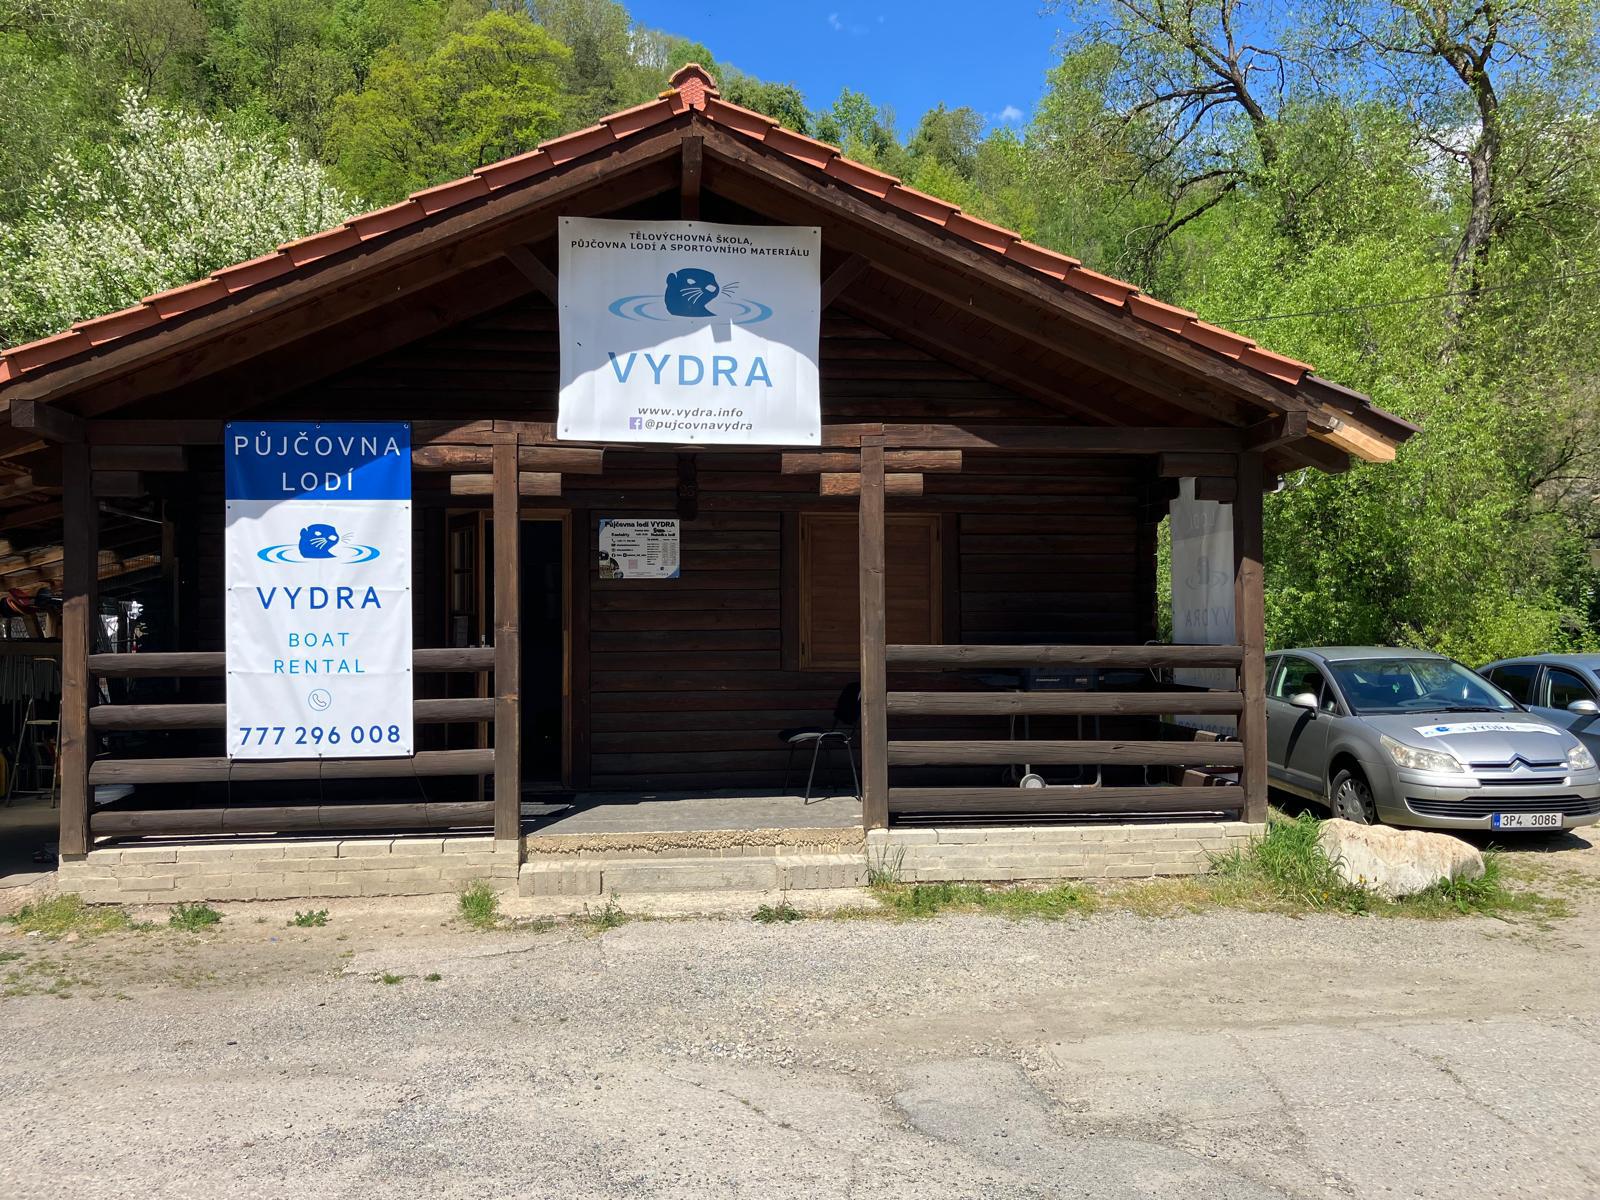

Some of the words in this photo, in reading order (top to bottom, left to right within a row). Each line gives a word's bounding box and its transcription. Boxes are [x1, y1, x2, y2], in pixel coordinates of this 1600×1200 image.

[629, 231, 713, 243] TĚLOVÝCHOVNÁ
[716, 233, 753, 245] ŠKOLA,
[571, 238, 627, 249] PŮJČOVNA
[630, 241, 657, 251] LODÍ
[660, 243, 667, 251] A
[670, 243, 747, 255] SPORTOVNÍHO
[750, 246, 810, 257] MATERIÁLU
[608, 351, 773, 388] VYDRA
[638, 407, 744, 419] www.vydra.info
[645, 419, 753, 432] @pujcovnavydra
[234, 430, 401, 456] PŮJČOVNA
[282, 467, 353, 491] LODÍ
[256, 586, 382, 610] VYDRA
[288, 632, 350, 648] BOAT
[274, 658, 366, 674] RENTAL
[239, 727, 286, 745] 777
[294, 726, 342, 745] 296
[350, 724, 401, 744] 008
[1502, 815, 1523, 826] 3P4
[1531, 814, 1558, 826] 3086
